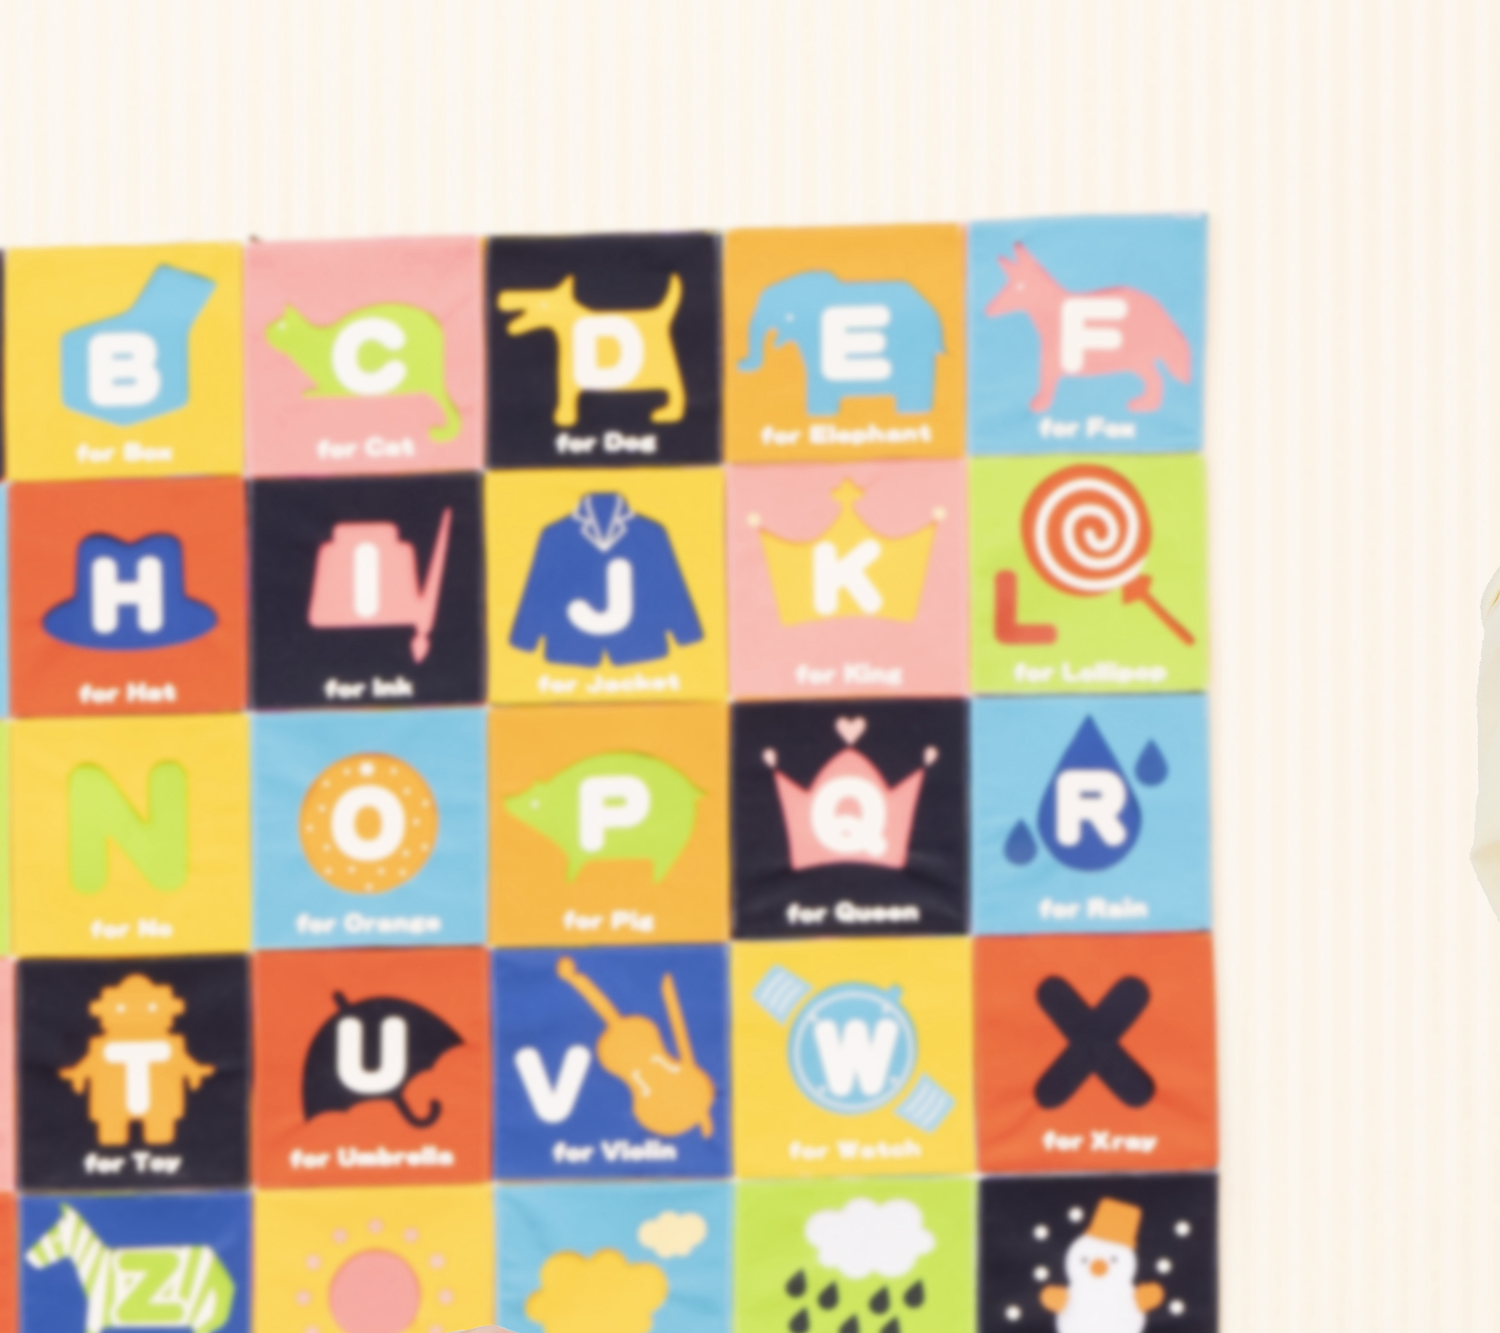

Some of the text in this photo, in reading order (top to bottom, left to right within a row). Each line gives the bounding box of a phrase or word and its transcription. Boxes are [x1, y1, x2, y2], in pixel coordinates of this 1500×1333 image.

[86, 331, 162, 409] B
[330, 315, 408, 396] C
[571, 315, 646, 391] D
[819, 304, 893, 383] E
[1059, 297, 1129, 376] F
[75, 441, 174, 464] for Box
[315, 436, 416, 460] for Cat
[554, 431, 658, 455] for Dog
[759, 424, 933, 447] for Elephant
[1037, 416, 1137, 440] for Fox
[90, 555, 165, 635] H
[352, 542, 380, 619] I
[566, 557, 635, 637] J
[811, 539, 884, 618] K
[993, 569, 1058, 645] L
[77, 683, 178, 705] for Hat
[323, 677, 414, 700] for Ink
[536, 673, 682, 695] for Jacket
[793, 662, 904, 687] for King
[1012, 661, 1169, 686] for Lollipop
[66, 759, 189, 896] N
[329, 786, 408, 863] O
[577, 776, 652, 854] P
[809, 775, 890, 859] Q
[1054, 768, 1128, 848] R
[89, 919, 174, 941] for No
[294, 911, 443, 936] for Orange
[562, 909, 656, 934] for Pig
[785, 901, 921, 925] for Queen
[1037, 897, 1150, 921] for Rain
[102, 1040, 173, 1117] T
[335, 1016, 408, 1096] U
[812, 1016, 901, 1097] W
[1033, 973, 1156, 1109] X
[513, 1044, 593, 1125] V
[83, 1151, 182, 1175] for Toy
[288, 1146, 455, 1170] for Umbrella
[551, 1139, 679, 1164] for Violin
[787, 1139, 923, 1162] for Watch
[1041, 1130, 1084, 1152] for
[113, 1249, 189, 1324] Z
